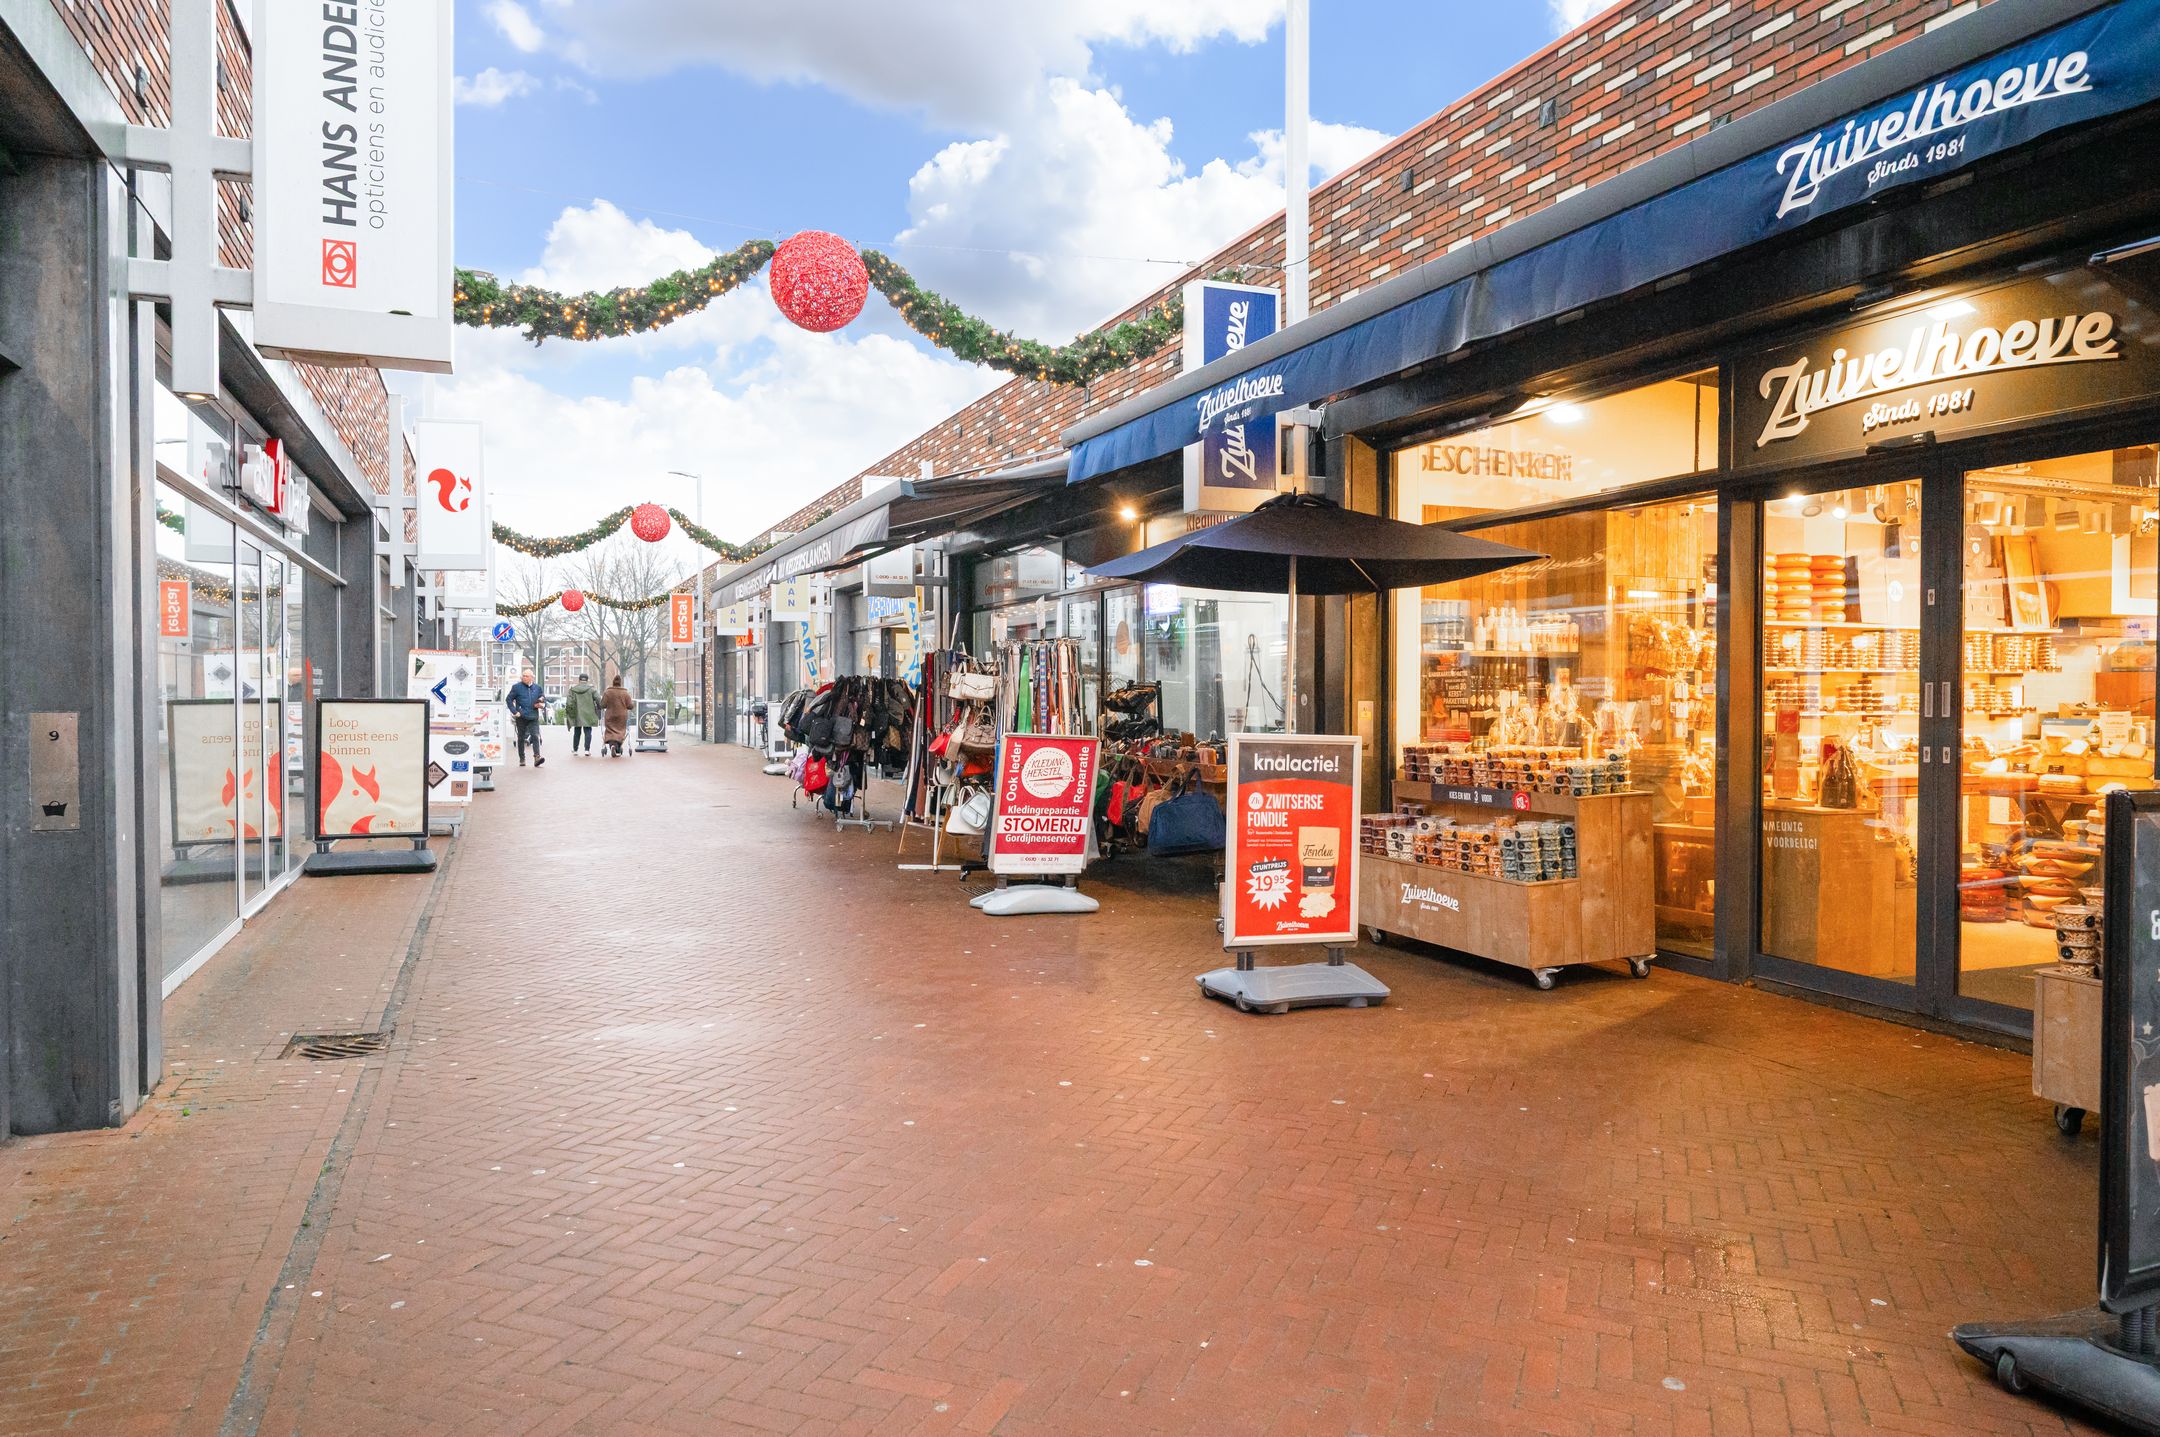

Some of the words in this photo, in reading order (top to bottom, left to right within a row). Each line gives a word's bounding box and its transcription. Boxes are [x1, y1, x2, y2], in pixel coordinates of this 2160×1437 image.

[322, 0, 358, 113] ANDE
[369, 86, 385, 114] en
[1776, 50, 2094, 219] Zuivelhoeve
[1867, 152, 1920, 189] Sinds
[1925, 134, 1965, 165] 1981
[322, 120, 358, 227] HANS
[368, 122, 388, 229] opticiens
[1757, 311, 2119, 448] Zuivelhoeve
[1197, 374, 1285, 435] Zuivelhoeve
[1862, 398, 1921, 432] Sinds
[1926, 387, 1974, 416] 1981
[675, 599, 688, 639] terStal
[329, 718, 359, 730] Loop
[48, 730, 60, 741] 9
[328, 732, 368, 744] gerust
[370, 732, 399, 742] eens
[329, 744, 371, 756] binnen
[1009, 742, 1023, 774] leder
[1026, 766, 1062, 778] HERSTEL
[1031, 757, 1066, 769] KLEDING
[1254, 753, 1339, 773] knalactie!
[1073, 746, 1090, 803] Reparatie
[1006, 777, 1019, 802] Ook
[1008, 805, 1080, 816] Kledingreparatie
[1265, 793, 1324, 810] ZWITSERSE
[1003, 817, 1083, 832] STOMERIJ
[1247, 811, 1289, 828] FONDUE
[1763, 820, 1804, 833] NMEUNIG
[1005, 833, 1077, 844] Gordijnenservice
[1766, 836, 1817, 850] VOORDELIG!
[1303, 845, 1334, 857] Fondue
[1252, 861, 1287, 872] STUNTPRIJS
[1401, 882, 1460, 912] Zuivelhoeve
